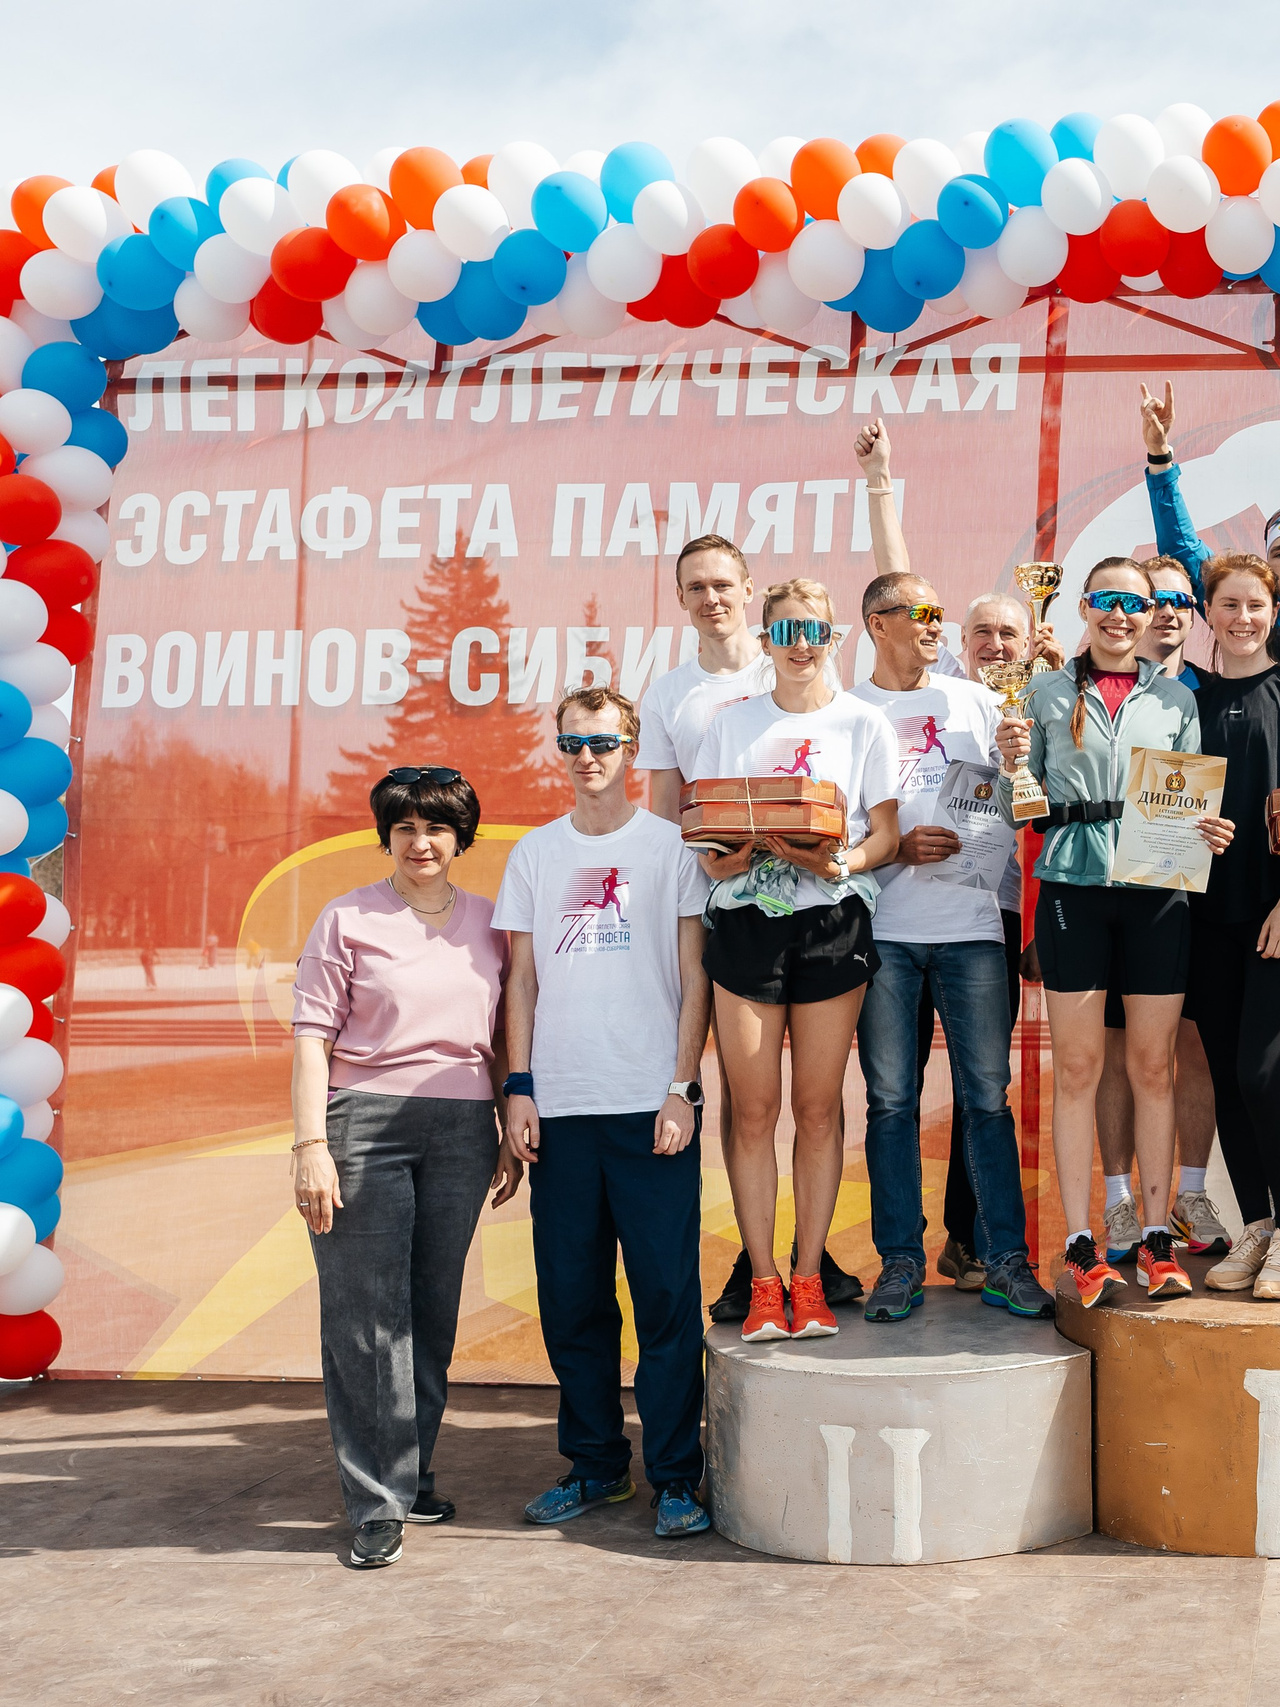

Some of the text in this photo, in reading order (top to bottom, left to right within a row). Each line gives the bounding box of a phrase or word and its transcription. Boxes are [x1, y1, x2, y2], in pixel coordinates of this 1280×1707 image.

[128, 343, 1021, 432] ЛЕГКОАТЛЕТИЧЕСКАЯ
[115, 483, 519, 567] ЭСТАФЕТА
[101, 626, 963, 708] ВОИНОВ-СИБИ
[910, 772, 946, 787] ЭСТАФ
[946, 796, 1001, 817] ДИПЛО
[1137, 790, 1208, 811] ДИПЛОМ
[1054, 899, 1068, 930] BIVIUM
[580, 931, 631, 944] ЭСТАФЕТА
